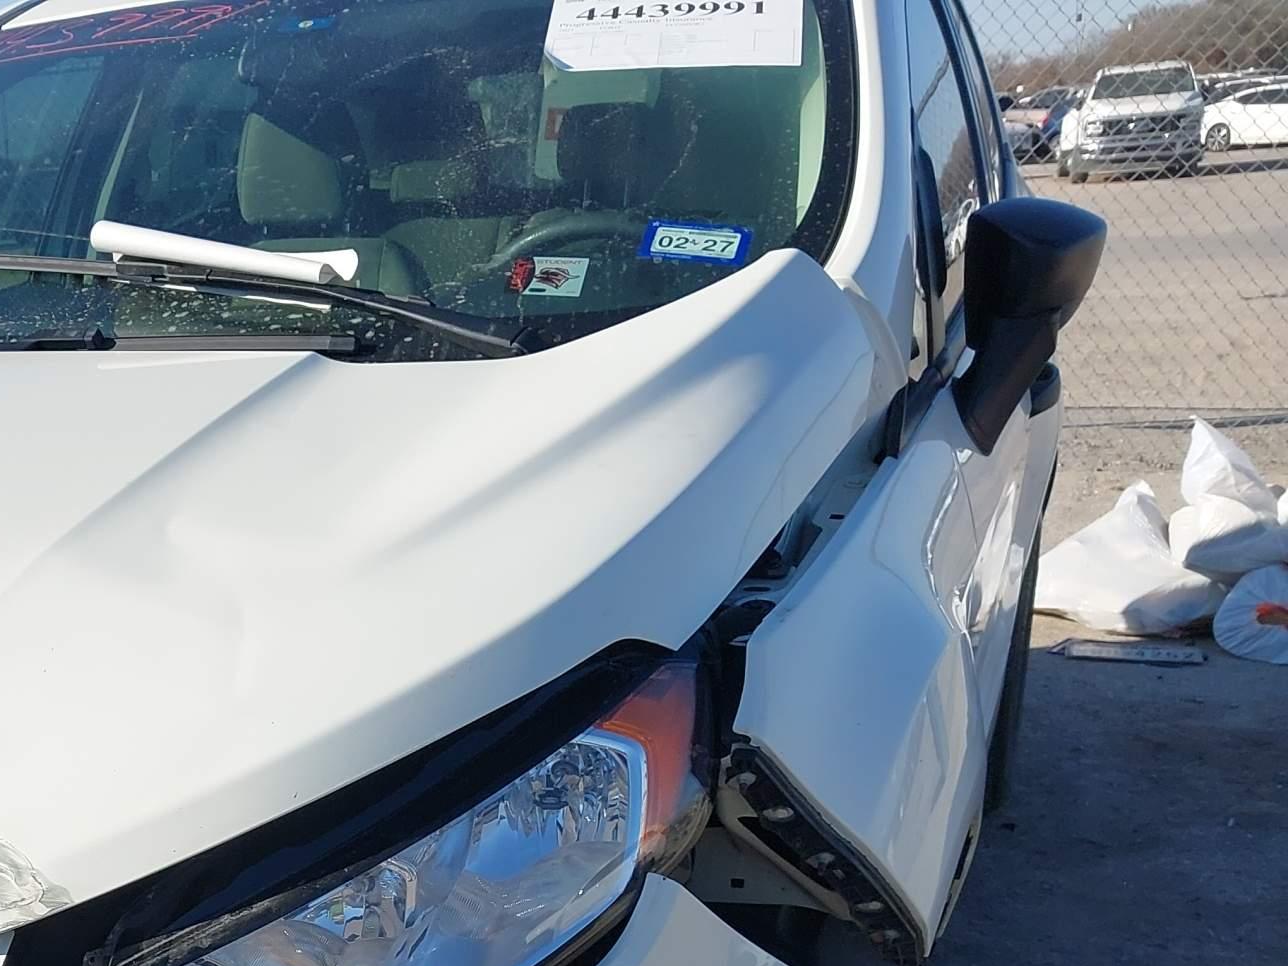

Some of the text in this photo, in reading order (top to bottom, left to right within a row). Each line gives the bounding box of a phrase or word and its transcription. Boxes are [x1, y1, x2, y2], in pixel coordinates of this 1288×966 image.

[575, 1, 766, 21] 44439991
[657, 235, 736, 253] 02 27
